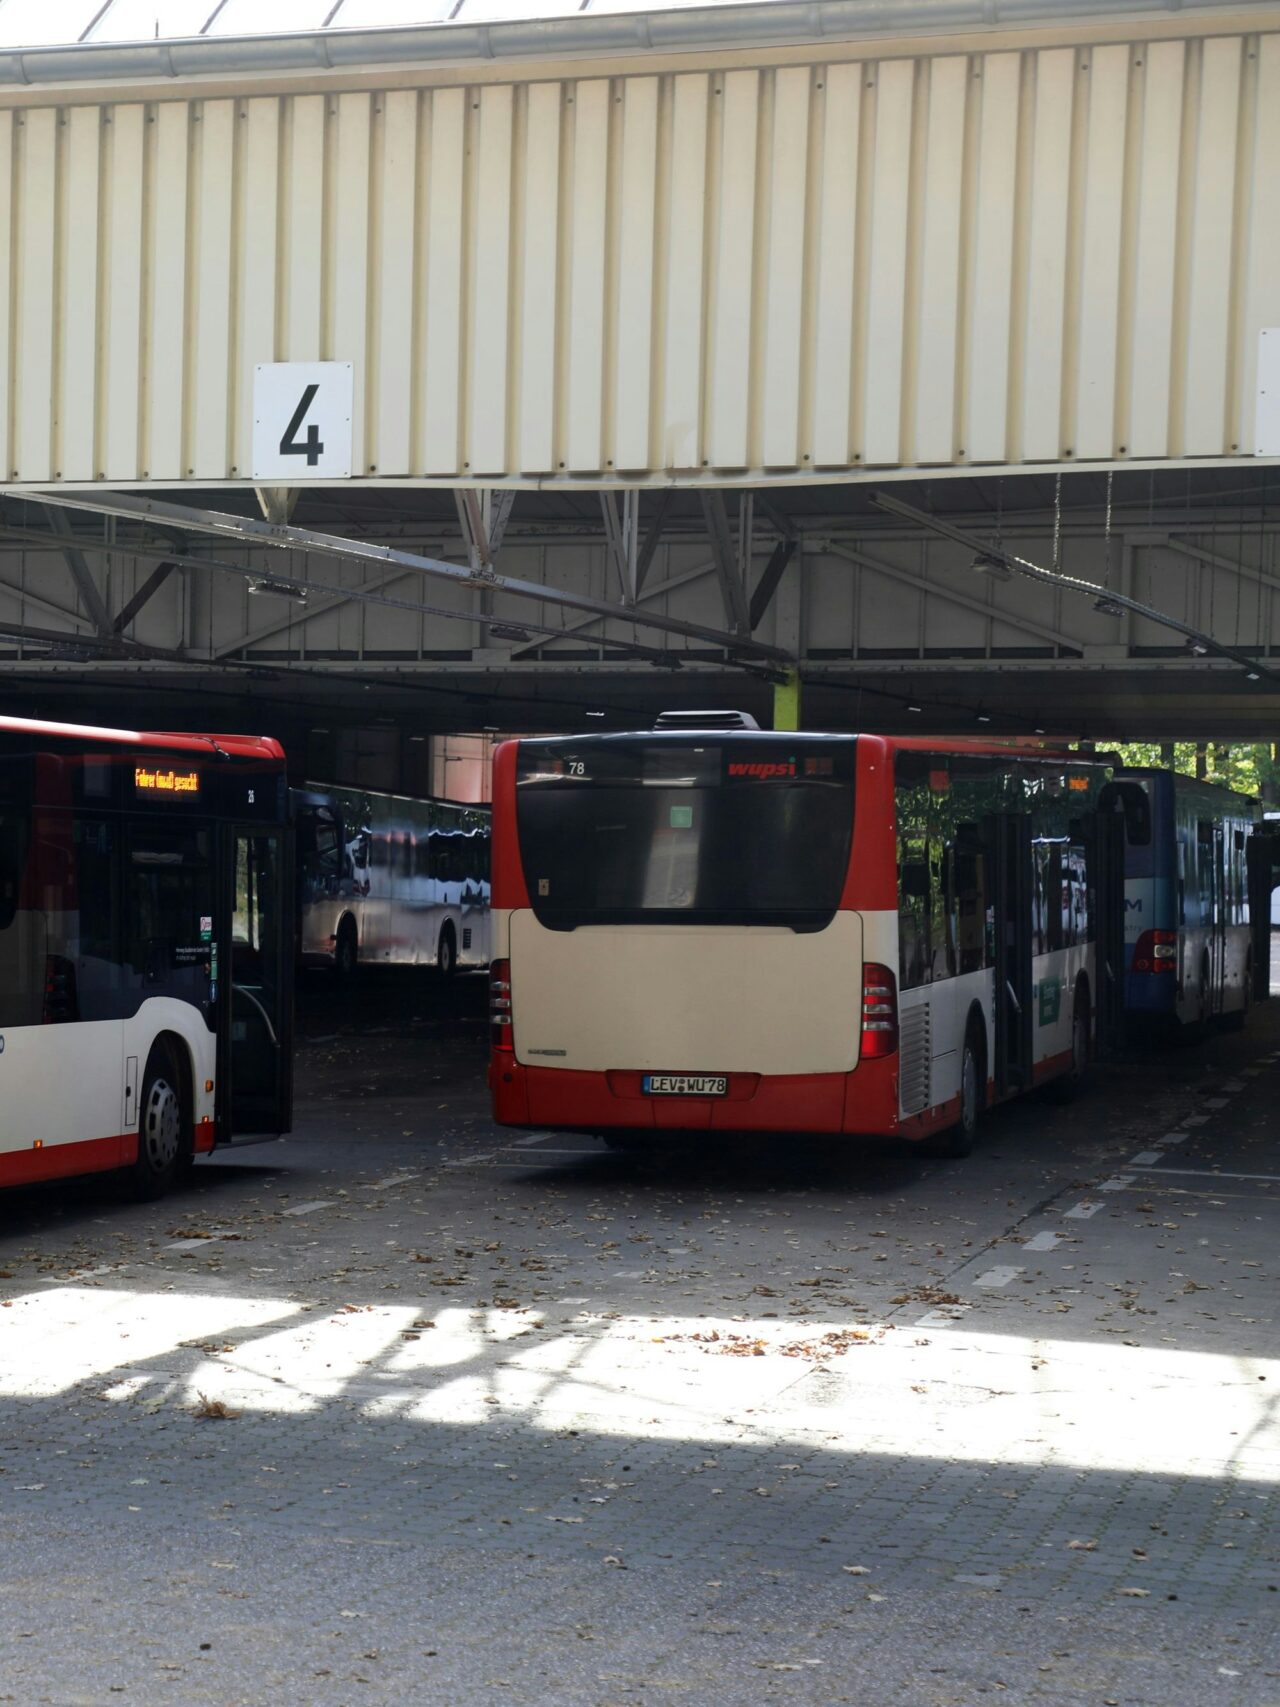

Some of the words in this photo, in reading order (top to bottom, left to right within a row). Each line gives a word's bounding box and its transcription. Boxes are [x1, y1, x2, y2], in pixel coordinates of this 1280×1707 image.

[280, 384, 324, 466] 4
[569, 762, 585, 775] 78
[728, 756, 796, 780] wupsi
[651, 1078, 677, 1091] LEV
[687, 1079, 704, 1092] WU
[708, 1079, 725, 1092] 78
